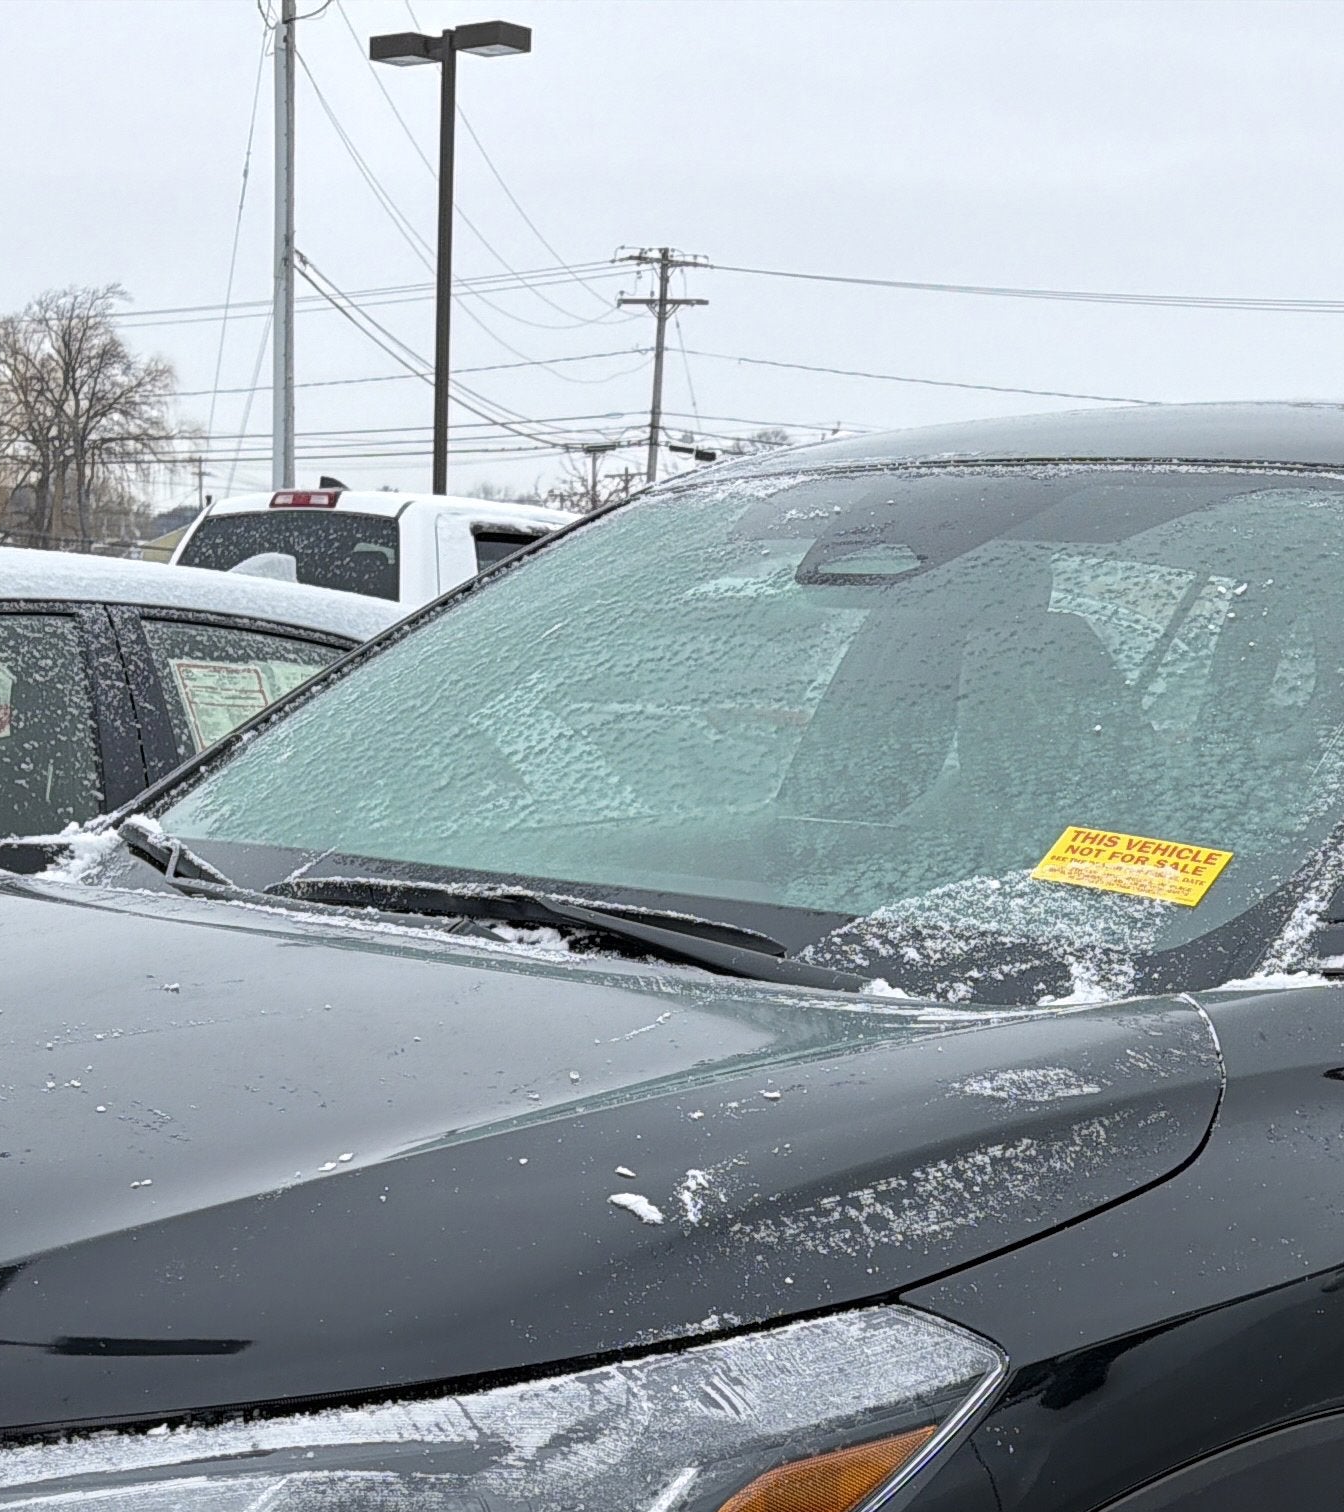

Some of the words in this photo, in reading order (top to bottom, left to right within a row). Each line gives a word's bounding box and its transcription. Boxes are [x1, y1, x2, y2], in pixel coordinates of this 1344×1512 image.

[1064, 844, 1107, 859] NOT
[1108, 851, 1150, 866] FOR
[1153, 859, 1208, 877] SALE
[1071, 829, 1121, 848] THIS
[1125, 838, 1223, 866] VEHICLE
